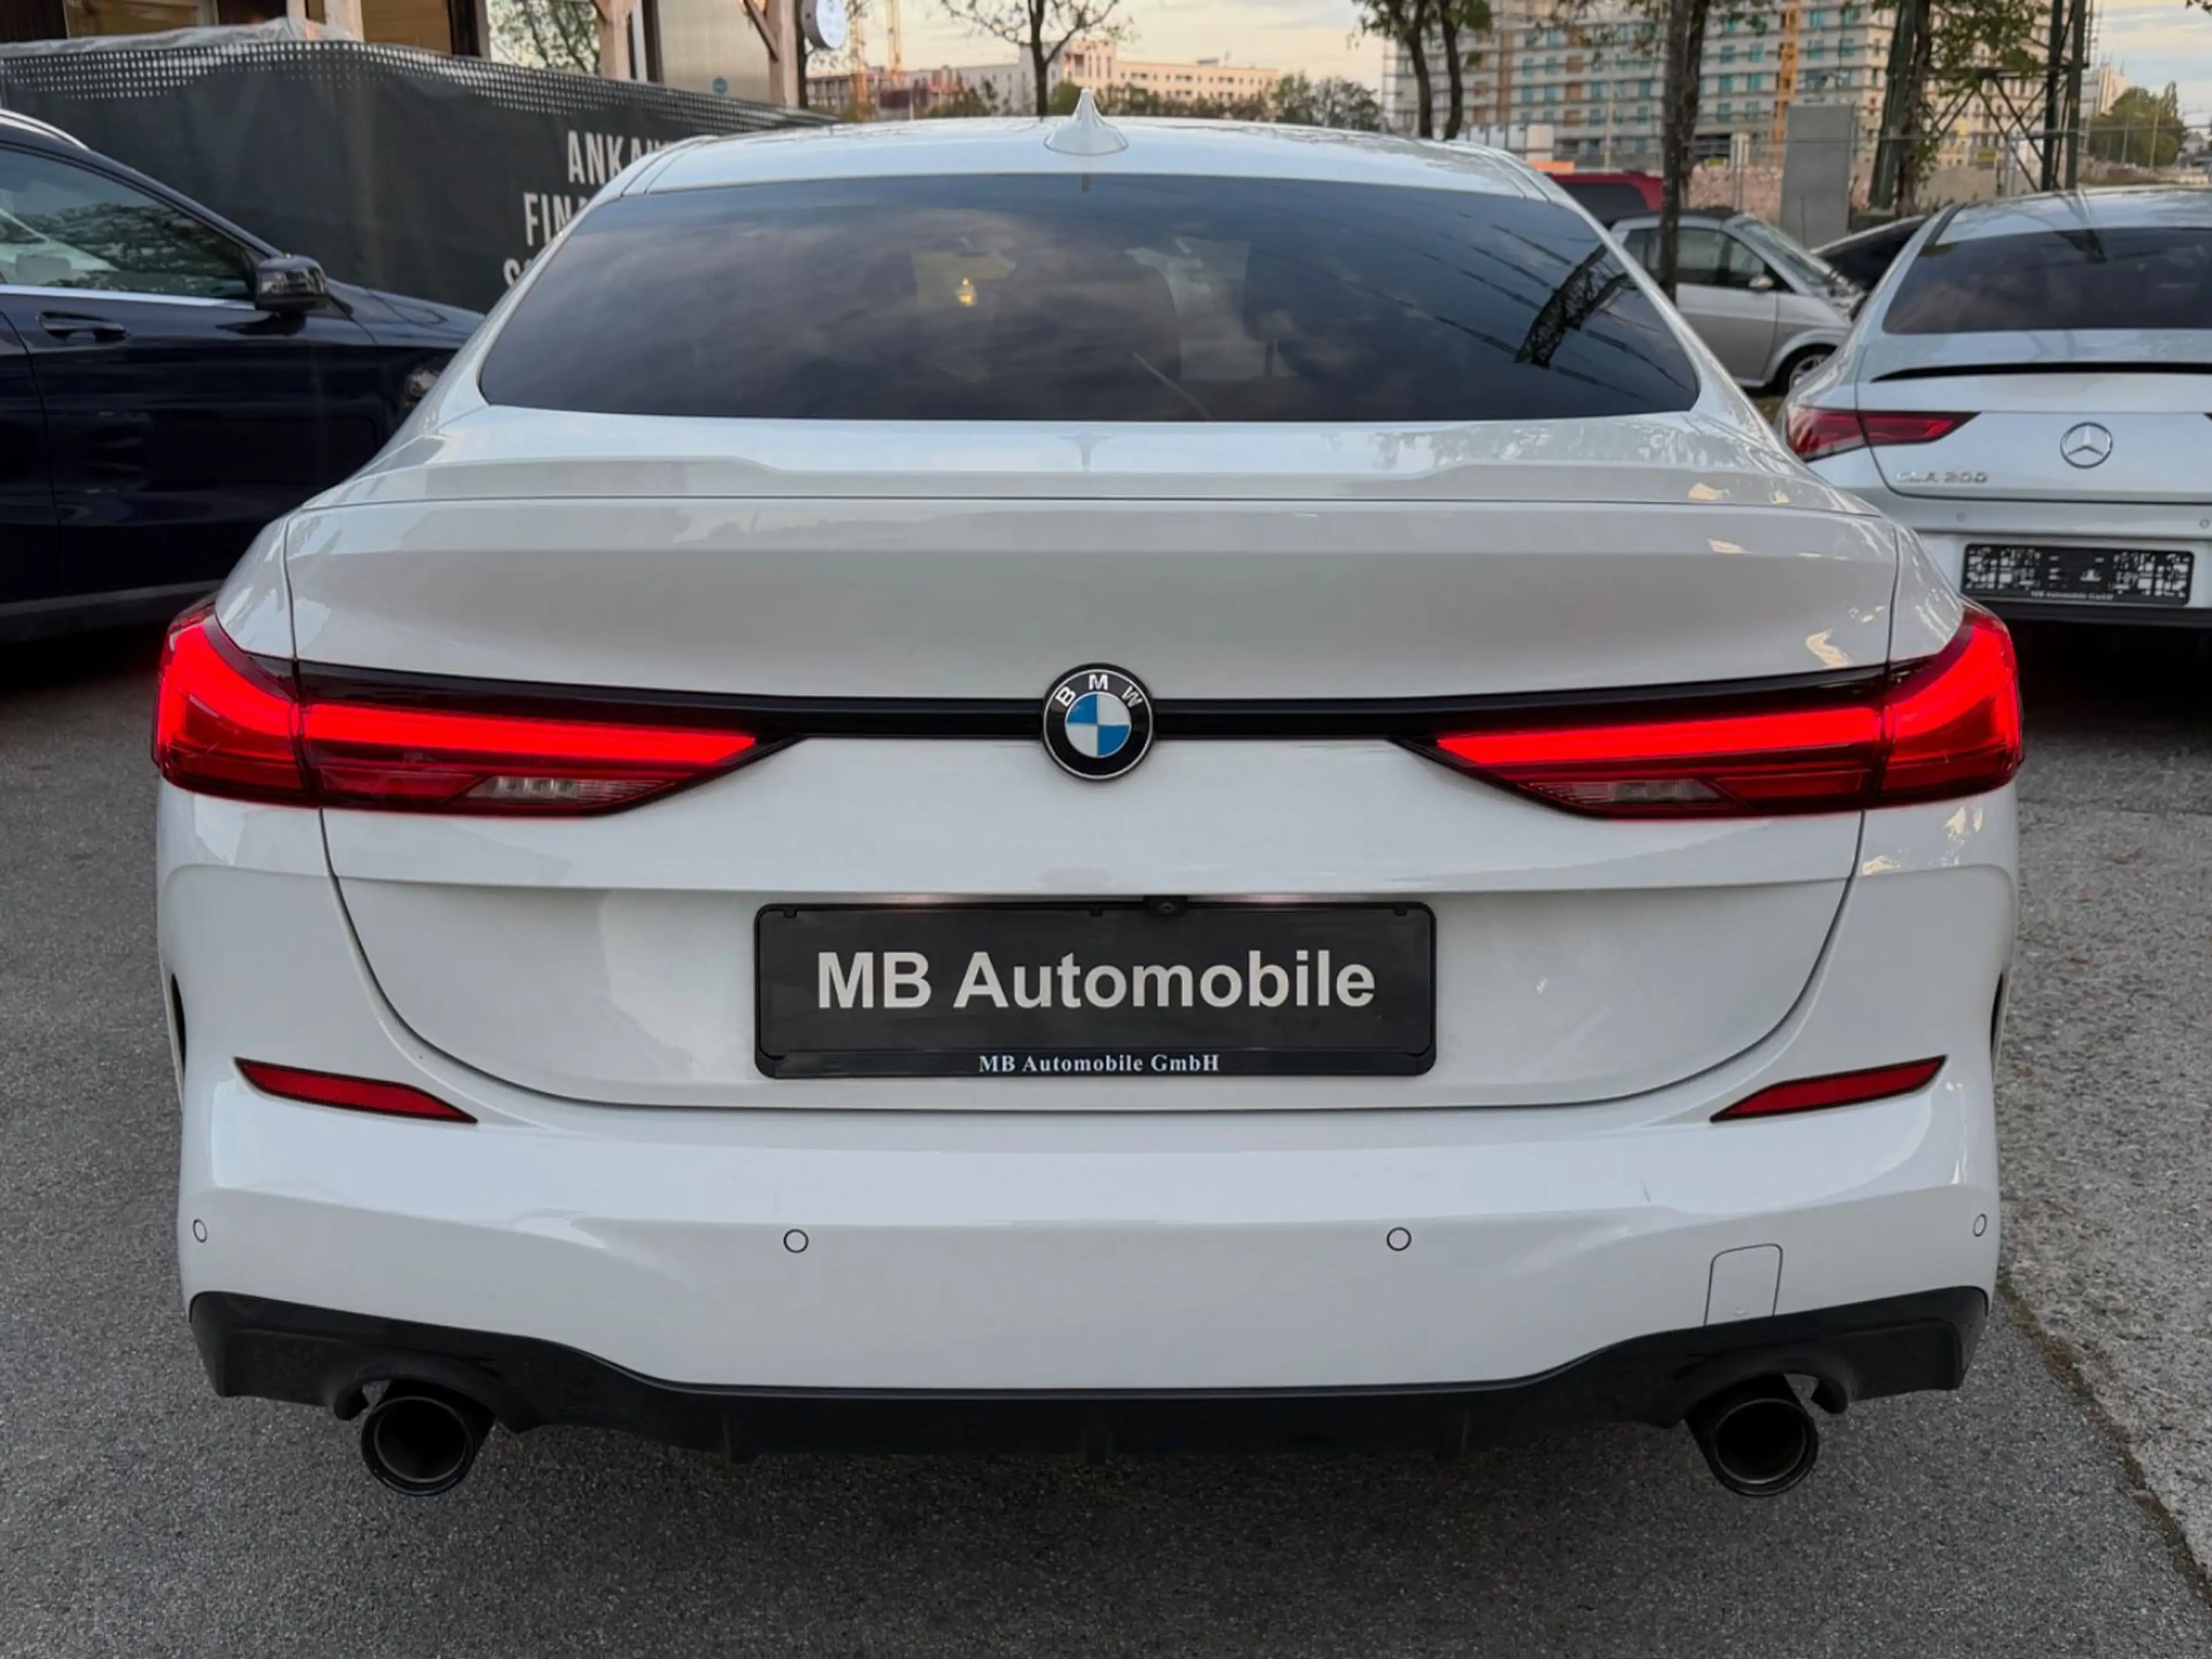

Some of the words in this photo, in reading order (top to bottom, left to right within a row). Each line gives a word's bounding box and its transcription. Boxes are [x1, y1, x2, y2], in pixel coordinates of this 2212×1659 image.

[523, 193, 588, 247] FIN
[1055, 673, 1143, 708] BMW
[817, 952, 931, 1009] MB
[953, 950, 1376, 1009] Automobile
[979, 1055, 1015, 1072] MB
[1022, 1055, 1143, 1072] Automobile
[1151, 1054, 1219, 1072] GmbH
